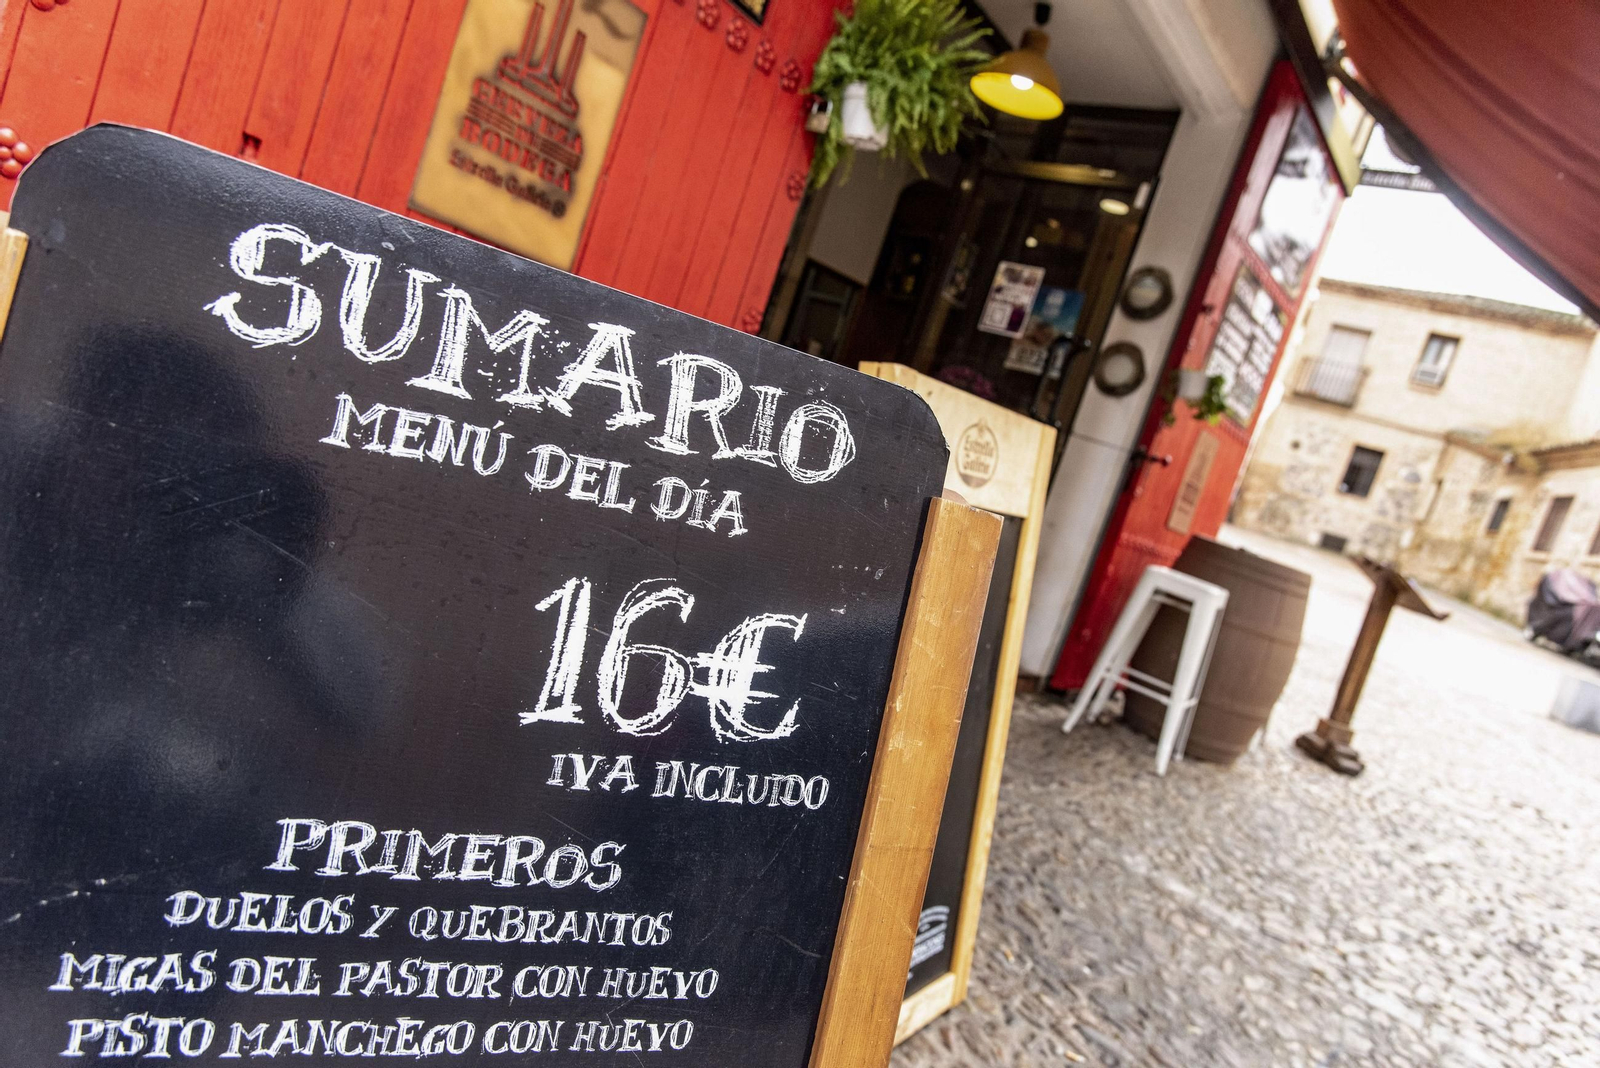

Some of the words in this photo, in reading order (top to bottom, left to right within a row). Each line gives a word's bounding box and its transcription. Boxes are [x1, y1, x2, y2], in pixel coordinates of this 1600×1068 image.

[203, 223, 856, 485] SUMARIO
[319, 392, 515, 477] MENÚ
[524, 443, 637, 515] DEL
[650, 477, 749, 538] DÍA
[517, 576, 808, 744] 16€
[546, 753, 640, 794] IVA
[650, 760, 830, 810] INCLUIDO
[263, 817, 627, 892] PRIMEROS
[163, 889, 356, 935] DUELOS
[359, 904, 399, 938] Y
[409, 905, 674, 946] QUEBRANTOS
[48, 949, 218, 996] MIGAS
[226, 956, 321, 997] DEL
[332, 957, 504, 999] PASTOR
[509, 963, 593, 1000] CON
[597, 966, 720, 1000] HUEVO
[59, 1011, 217, 1058] PISTO
[219, 1016, 475, 1059] MANCHEGO
[480, 1020, 566, 1054] CON
[568, 1018, 694, 1053] HUEVO
